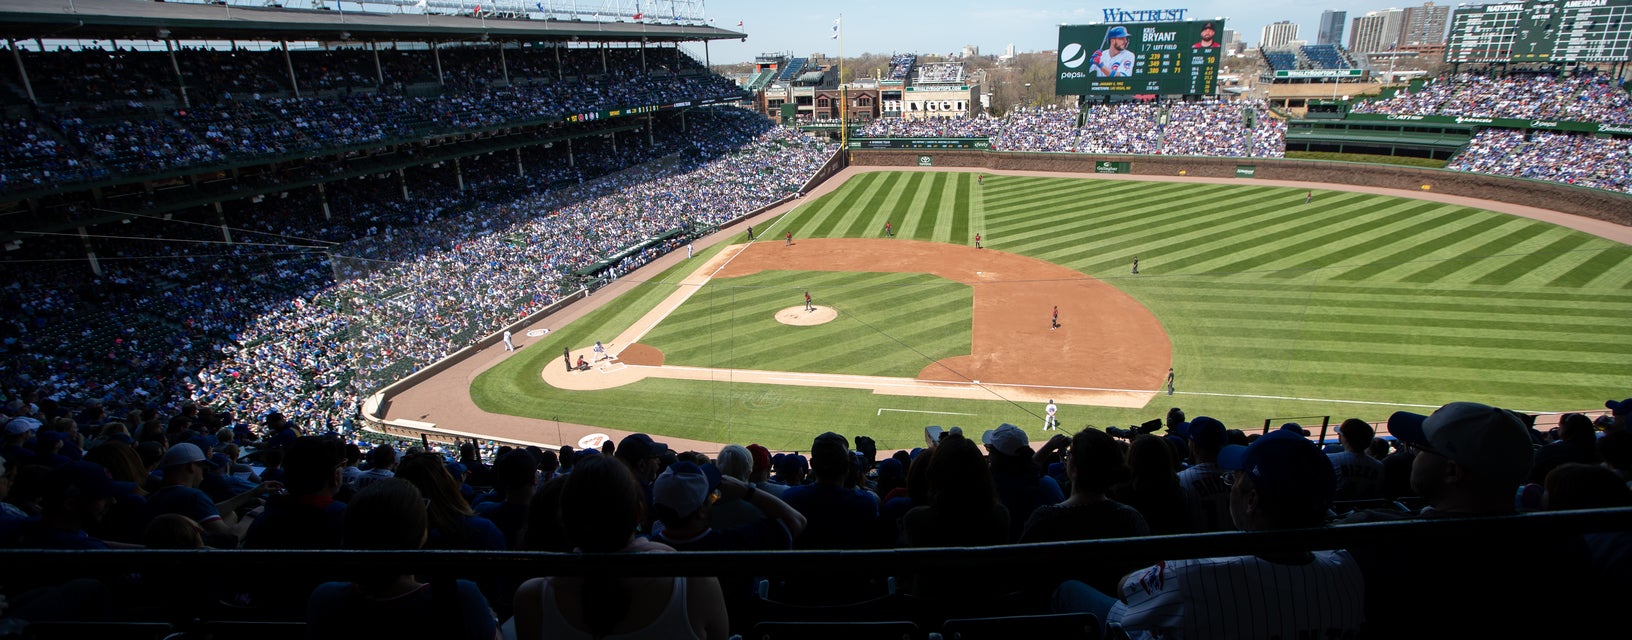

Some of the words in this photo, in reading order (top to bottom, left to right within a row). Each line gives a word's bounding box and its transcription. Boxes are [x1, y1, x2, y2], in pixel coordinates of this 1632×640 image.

[1487, 4, 1524, 12] NATIONAL
[1103, 8, 1187, 22] WINTRUST
[1142, 32, 1176, 42] BRYANT
